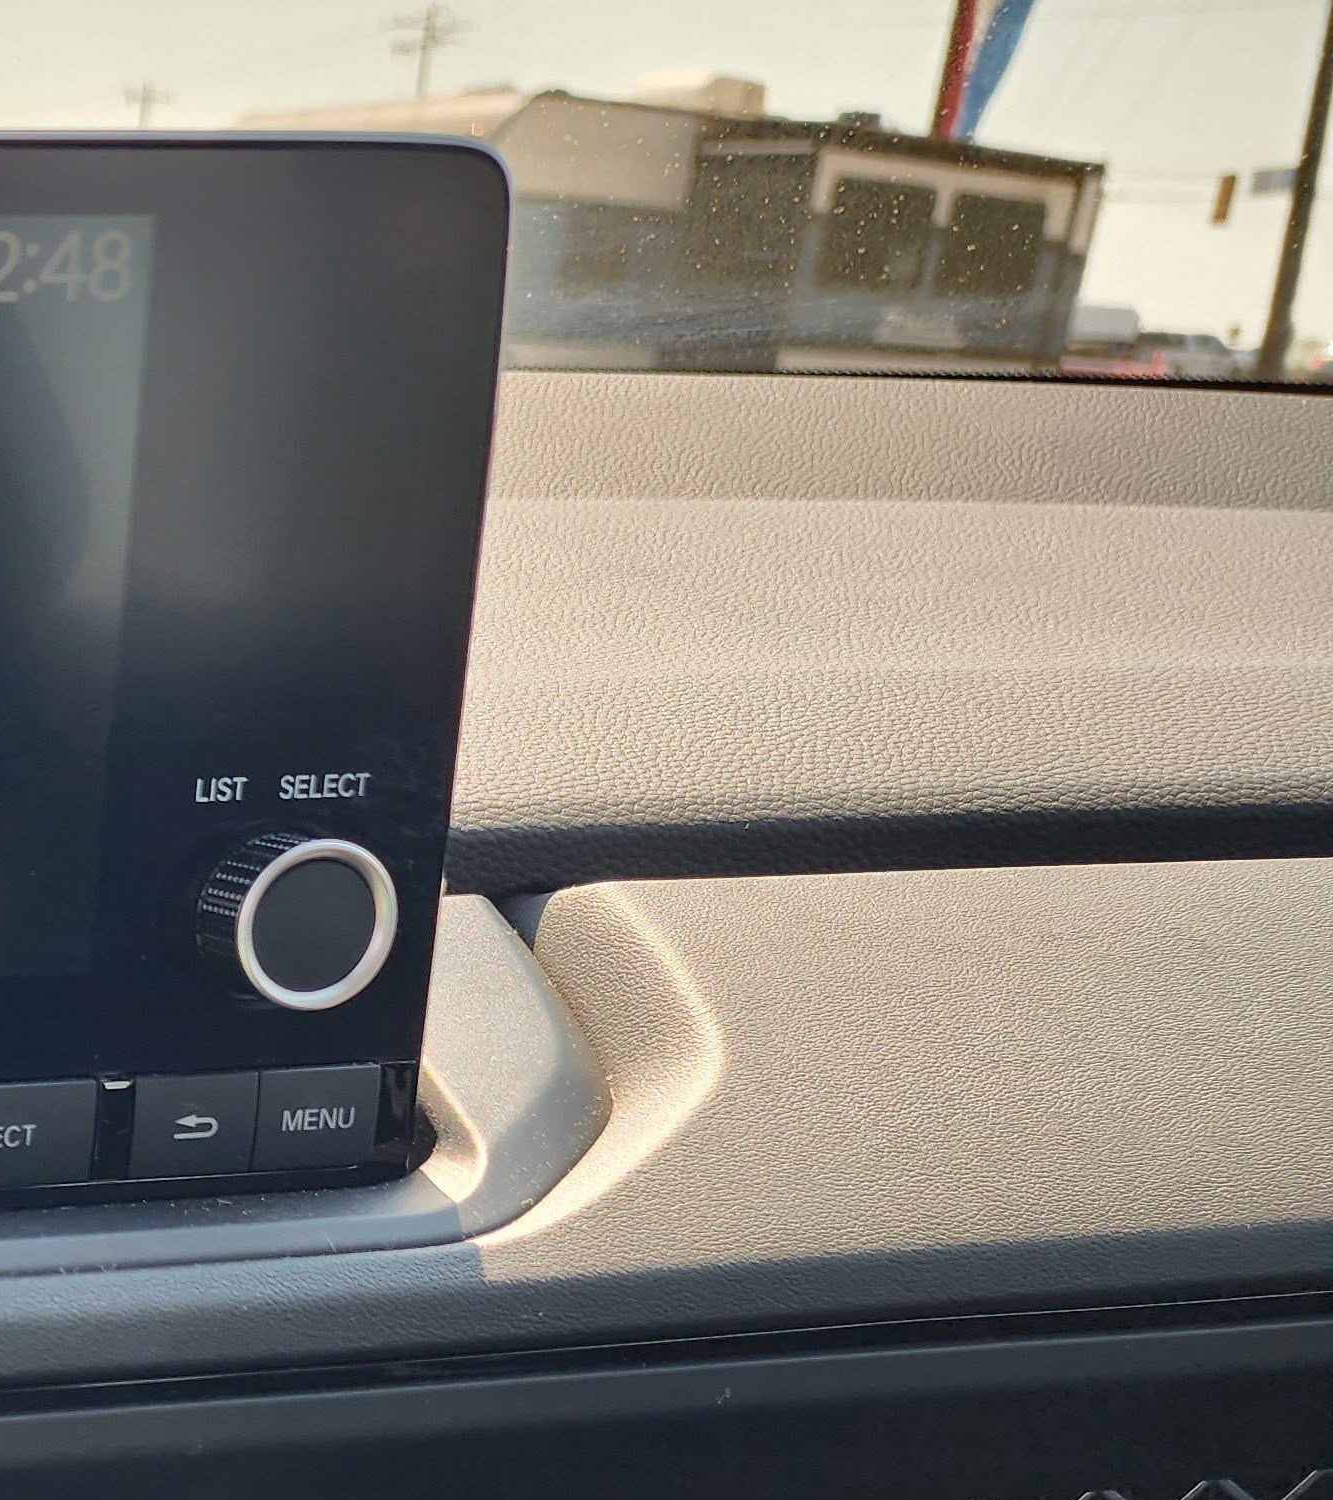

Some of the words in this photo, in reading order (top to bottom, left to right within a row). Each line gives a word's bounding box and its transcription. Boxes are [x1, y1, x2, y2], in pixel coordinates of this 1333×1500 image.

[195, 777, 248, 802] LIST
[279, 772, 371, 800] SELECT
[280, 1106, 357, 1134] MENU
